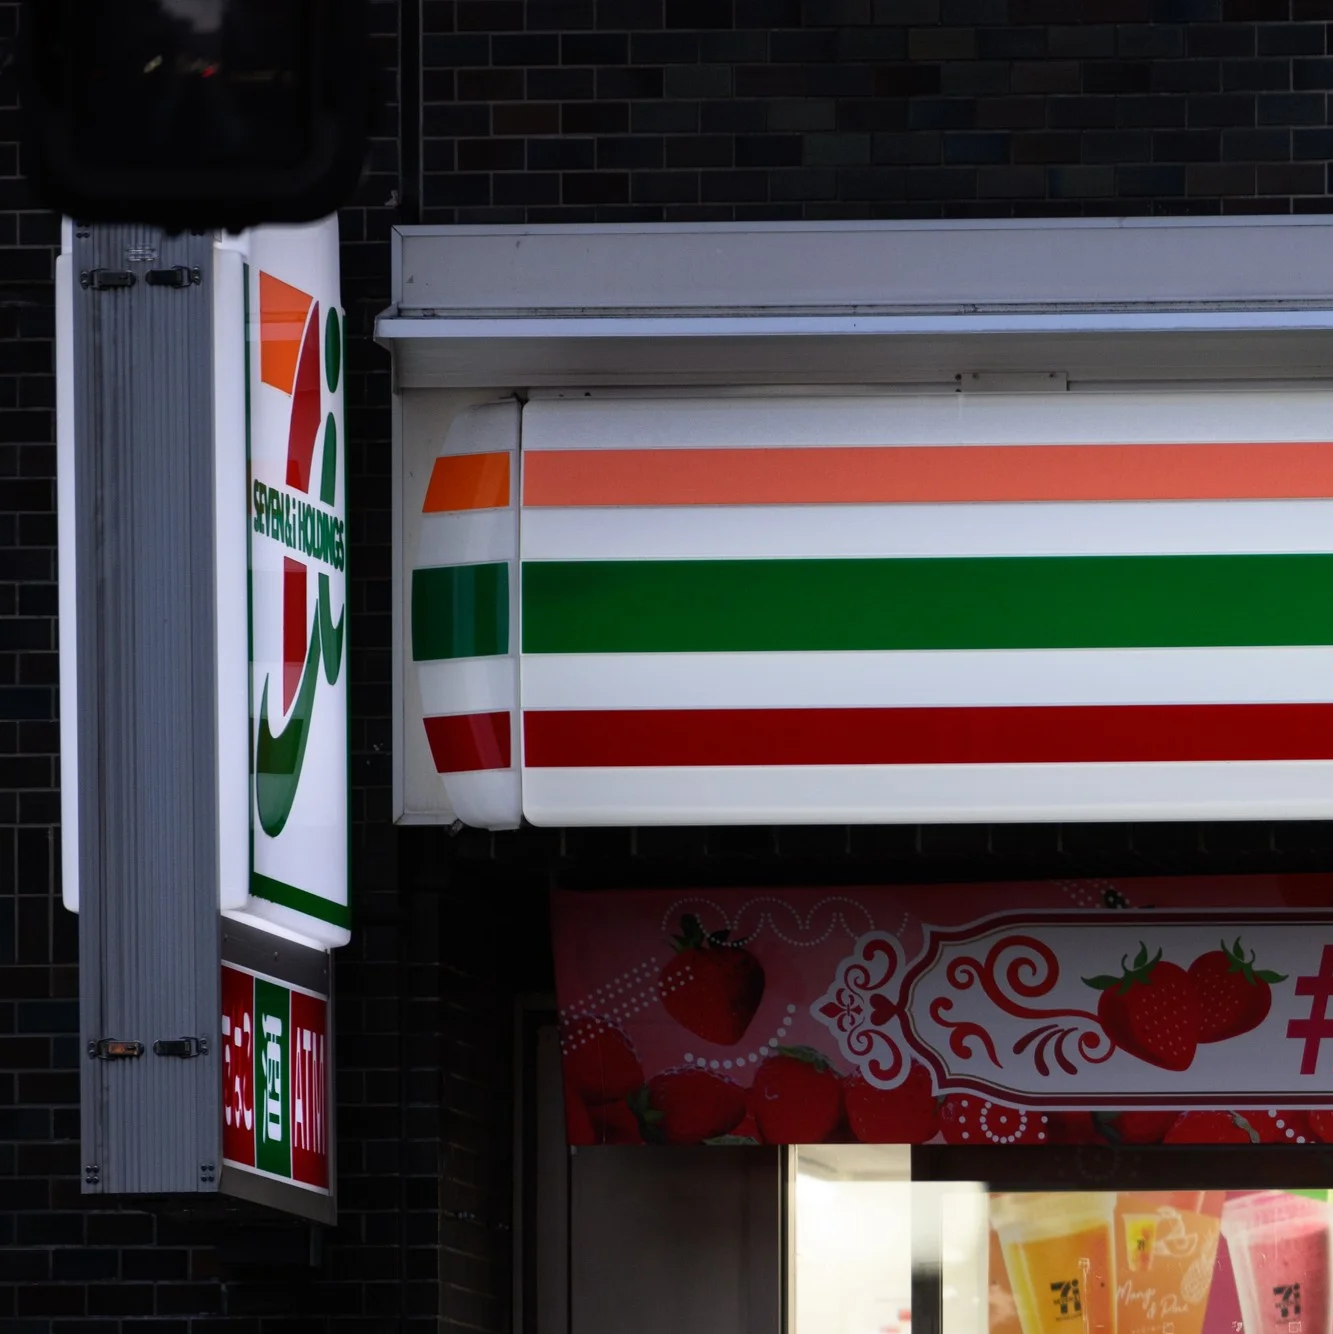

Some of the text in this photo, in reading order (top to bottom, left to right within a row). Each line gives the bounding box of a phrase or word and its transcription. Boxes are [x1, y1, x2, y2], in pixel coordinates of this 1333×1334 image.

[298, 500, 344, 573] HOLDINGS
[262, 1012, 282, 1143] 酒
[295, 1026, 325, 1155] ATM
